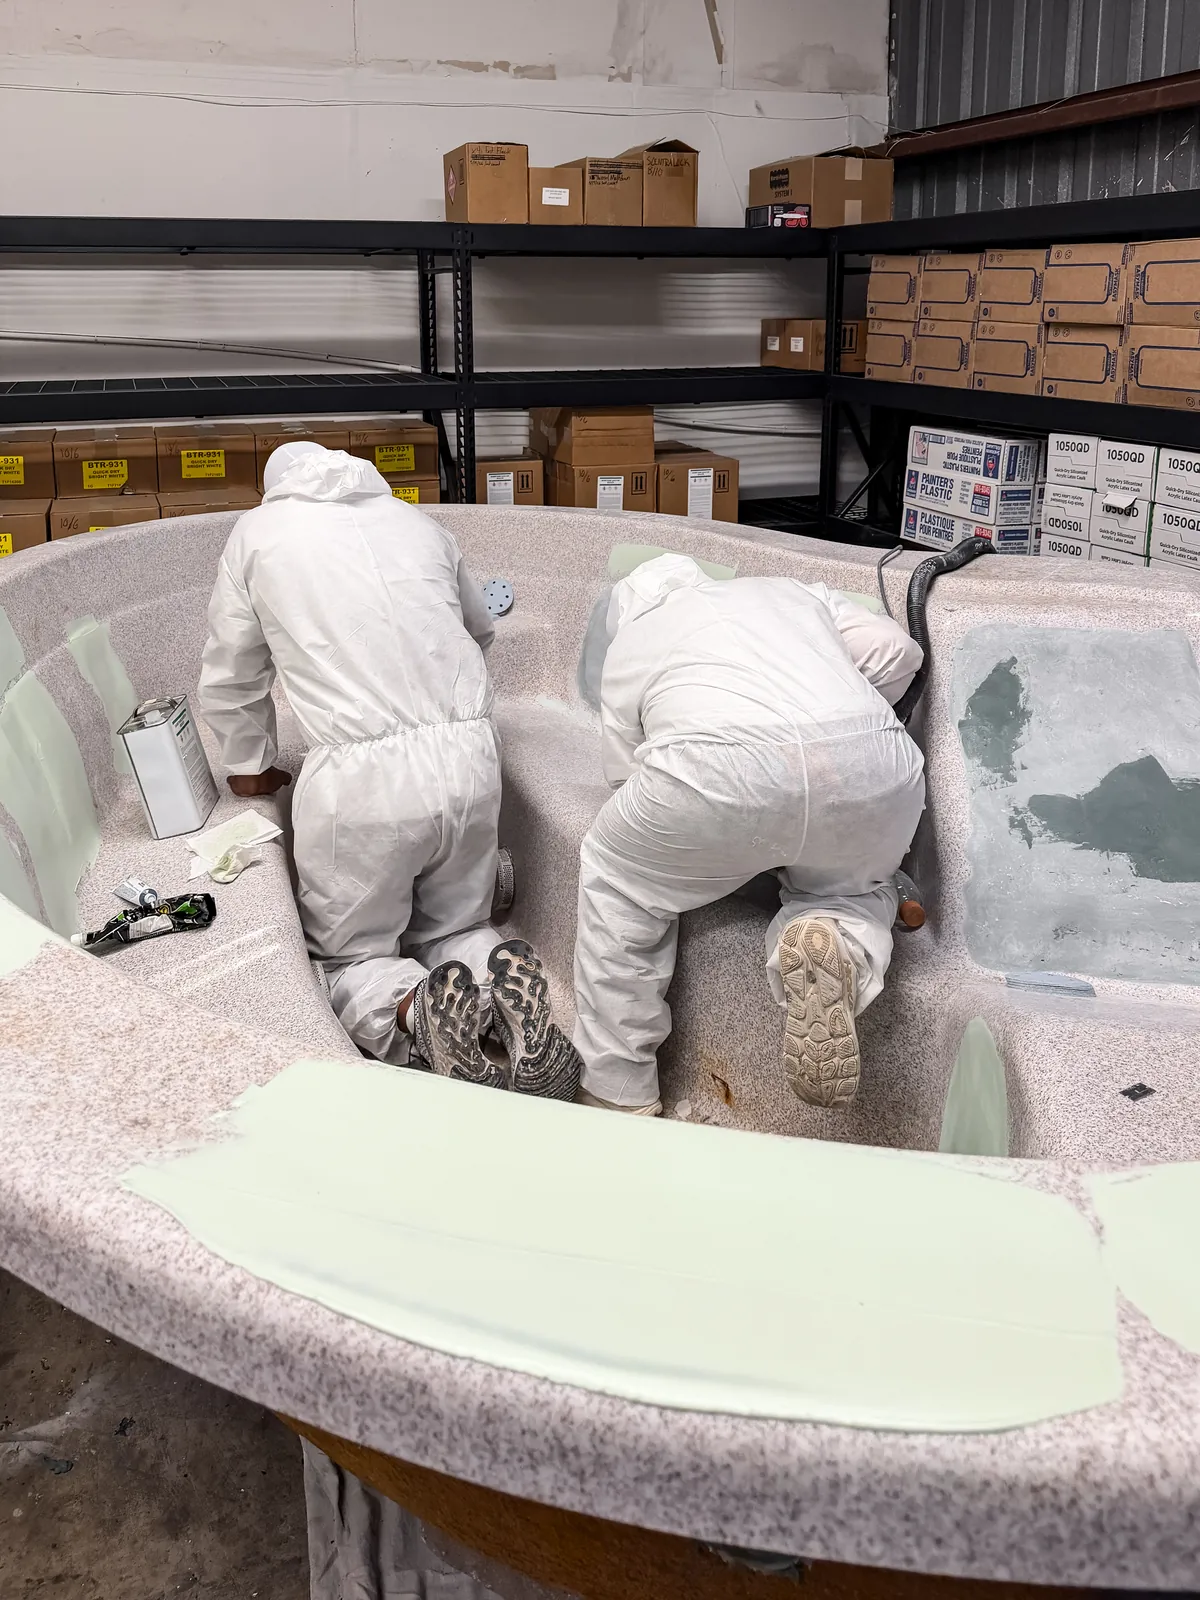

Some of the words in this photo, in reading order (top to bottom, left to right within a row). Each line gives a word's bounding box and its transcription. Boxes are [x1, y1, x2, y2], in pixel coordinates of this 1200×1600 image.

[1112, 268, 1120, 302] EASYMASK
[1110, 348, 1118, 382] EASYMASK
[962, 446, 982, 456] PEINTRES
[1056, 441, 1090, 453] 1050QD
[946, 452, 958, 460] POUR
[958, 454, 981, 464] PLASTIQUE
[1107, 449, 1144, 463] 1050QD
[943, 461, 959, 470] PLASTIC
[922, 473, 954, 489] PAINTER'S
[920, 485, 952, 500] PLASTIC
[1165, 486, 1184, 494] Quick-Dry
[60, 516, 79, 530] 10/6
[921, 512, 955, 530] PLASTIQUE
[1048, 518, 1082, 532] 1050QD
[920, 524, 932, 534] POUR
[932, 527, 954, 542] PEINTRES
[1048, 541, 1082, 556] 1050QD
[1160, 542, 1178, 551] Quick-Dry
